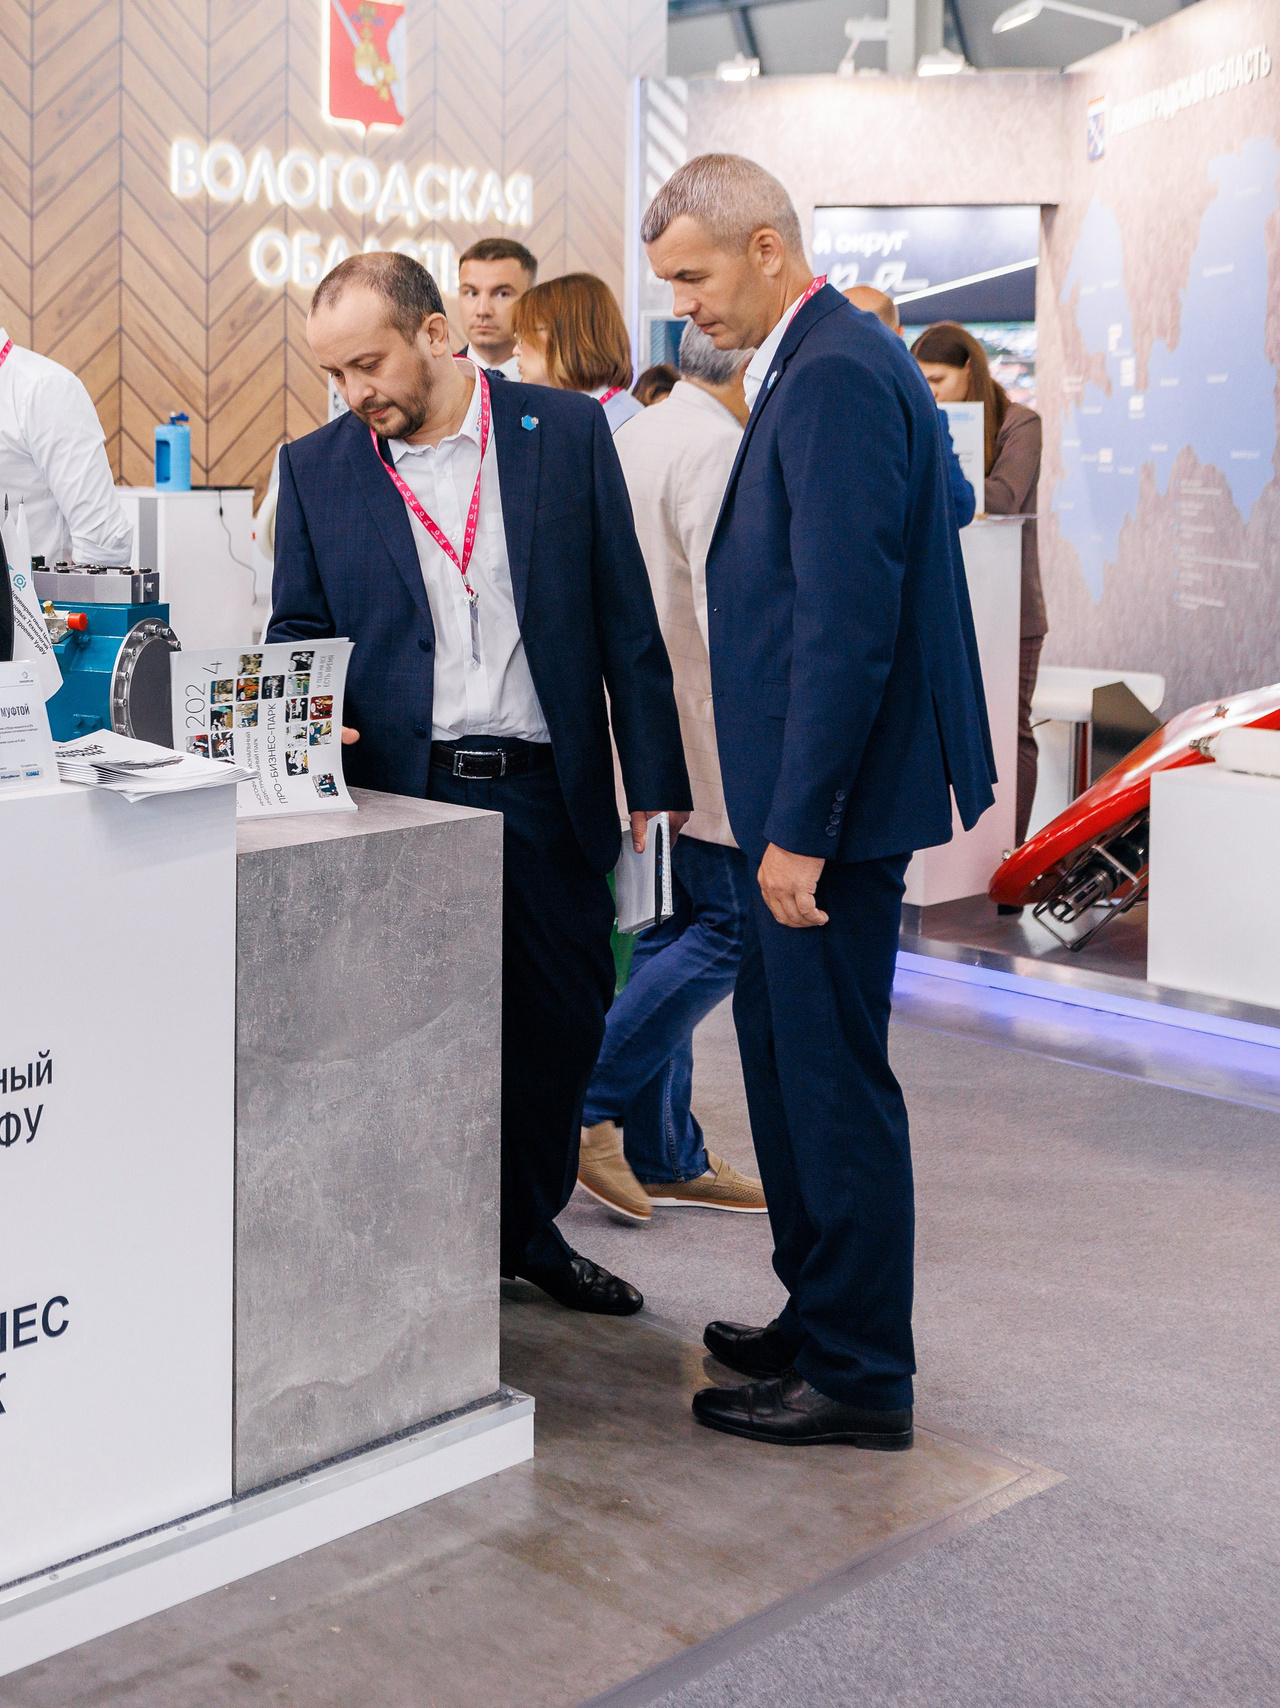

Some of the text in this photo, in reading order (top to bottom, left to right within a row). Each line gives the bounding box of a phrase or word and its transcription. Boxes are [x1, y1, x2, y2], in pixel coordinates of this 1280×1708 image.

[170, 139, 534, 226] ВОЛОГОДСКАЯ
[1, 703, 31, 718] МУФТОЙ
[266, 702, 289, 804] ПРО-БИЗНЕС-ПАРК
